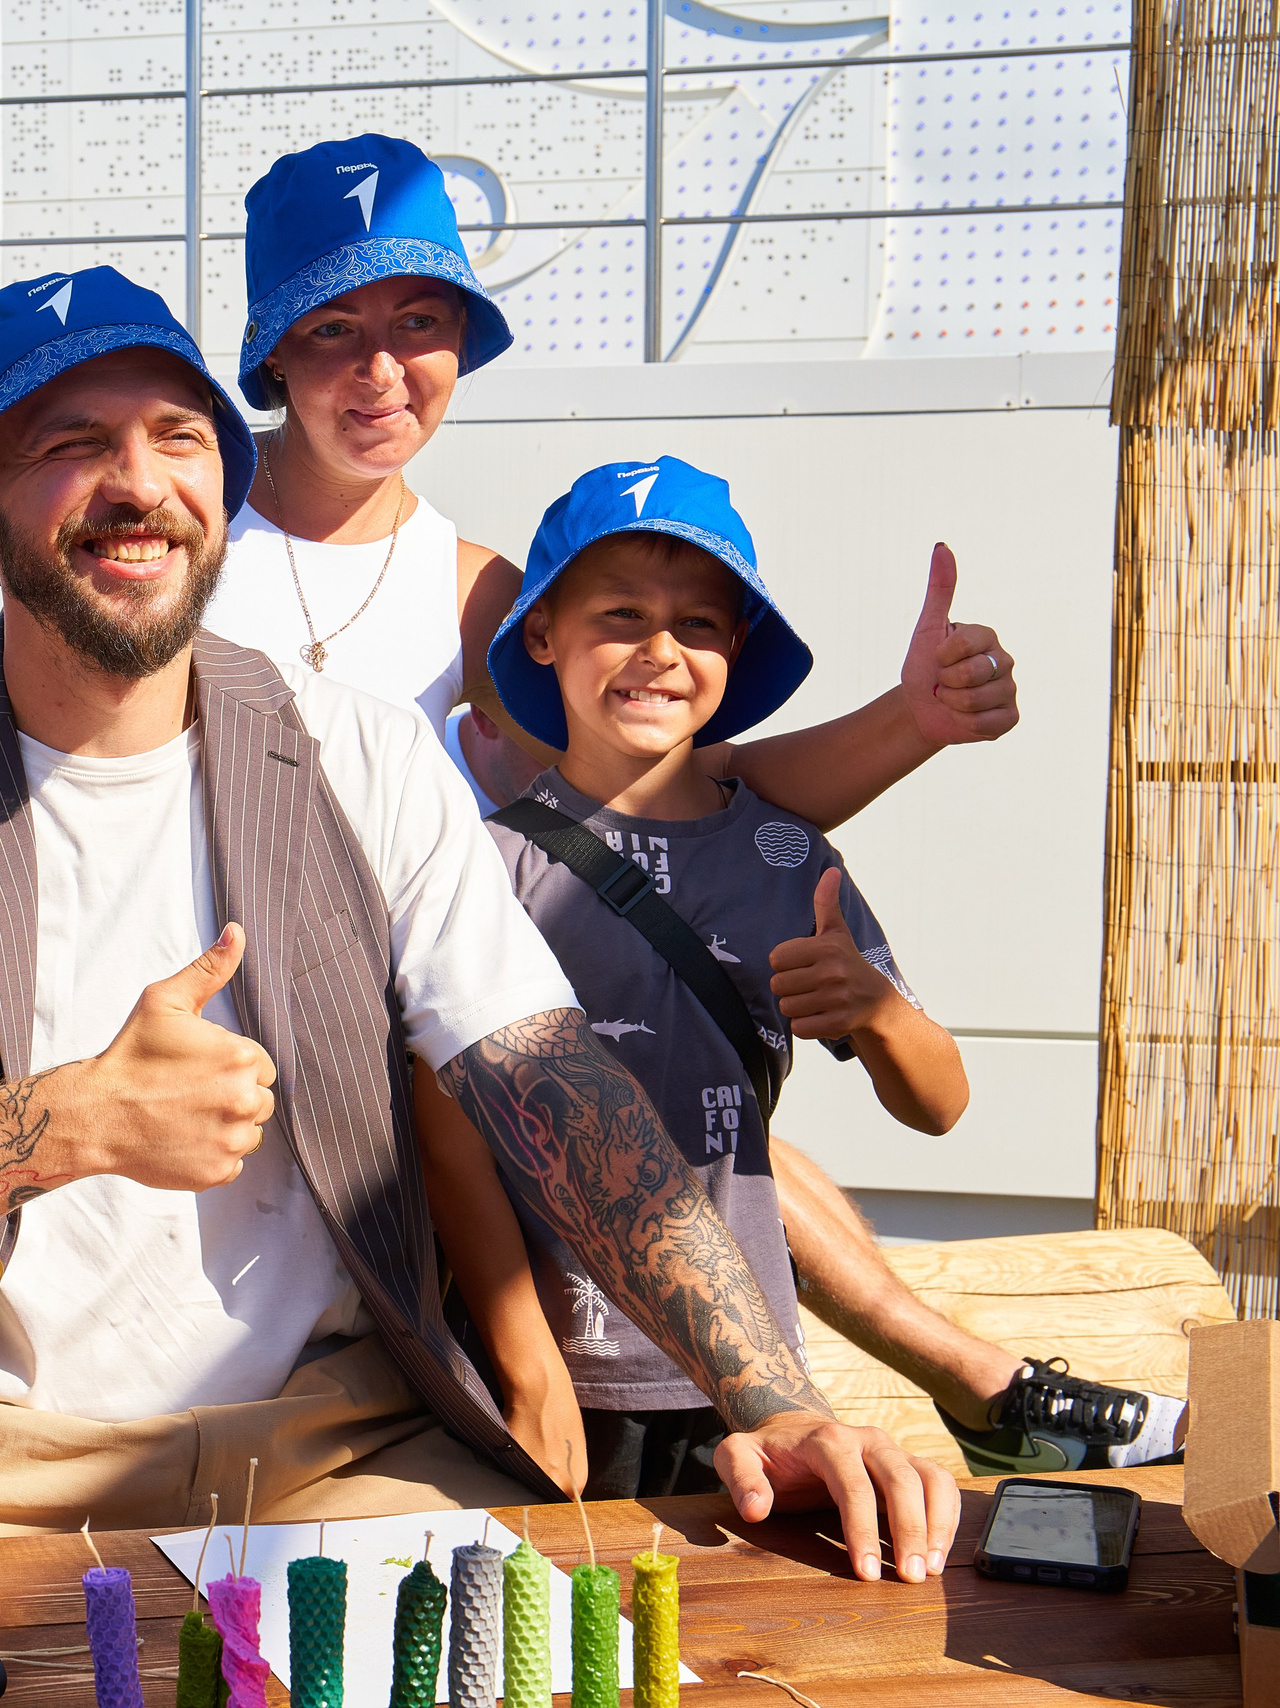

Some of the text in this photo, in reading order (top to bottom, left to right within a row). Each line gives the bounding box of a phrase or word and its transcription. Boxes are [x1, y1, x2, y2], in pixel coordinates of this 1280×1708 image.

[618, 852, 669, 872] FO
[704, 1108, 739, 1132] FO
[705, 1131, 738, 1154] NI
